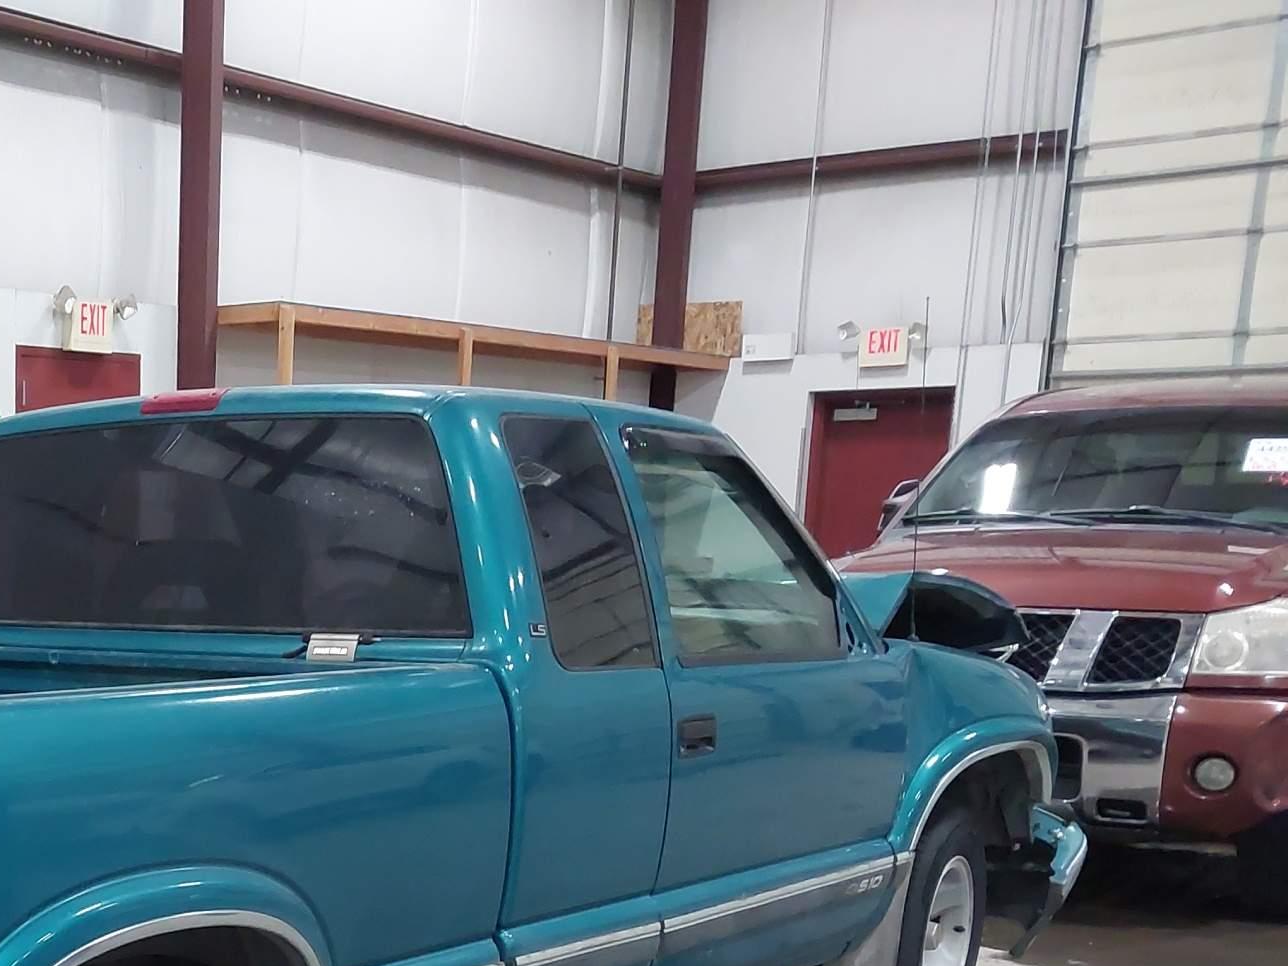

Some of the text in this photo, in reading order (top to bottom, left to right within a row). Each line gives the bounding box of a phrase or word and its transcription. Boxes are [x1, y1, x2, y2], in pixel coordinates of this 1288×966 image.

[80, 303, 107, 337] EXIT
[868, 329, 901, 354] EXIT
[529, 623, 547, 636] LS
